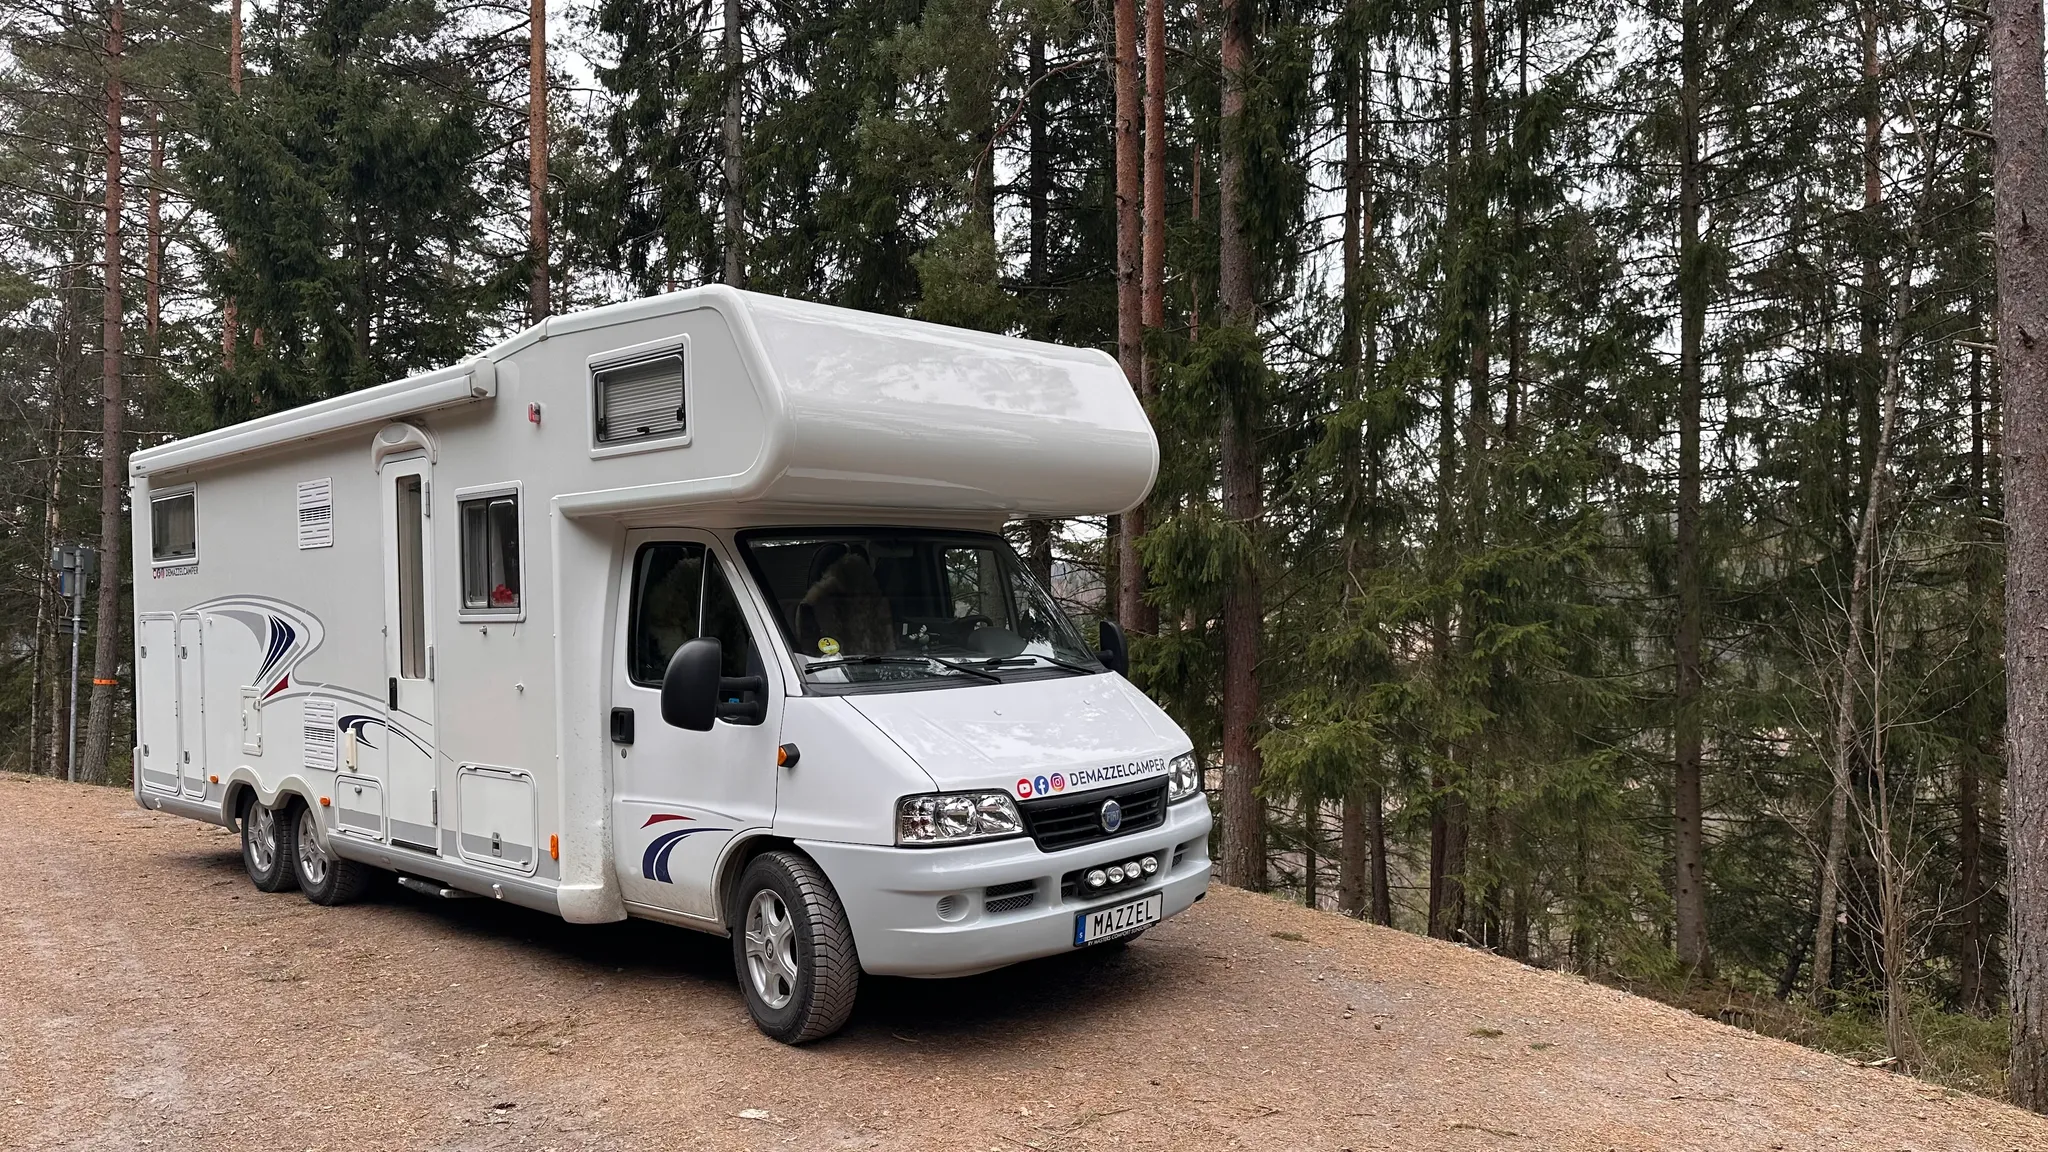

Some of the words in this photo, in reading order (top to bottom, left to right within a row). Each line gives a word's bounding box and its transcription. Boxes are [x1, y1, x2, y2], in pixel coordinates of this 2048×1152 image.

[823, 638, 831, 646] 3
[1069, 758, 1166, 786] DEMAZZELCAMPER
[1106, 809, 1120, 823] FIAT
[1094, 900, 1152, 936] MAZZEL
